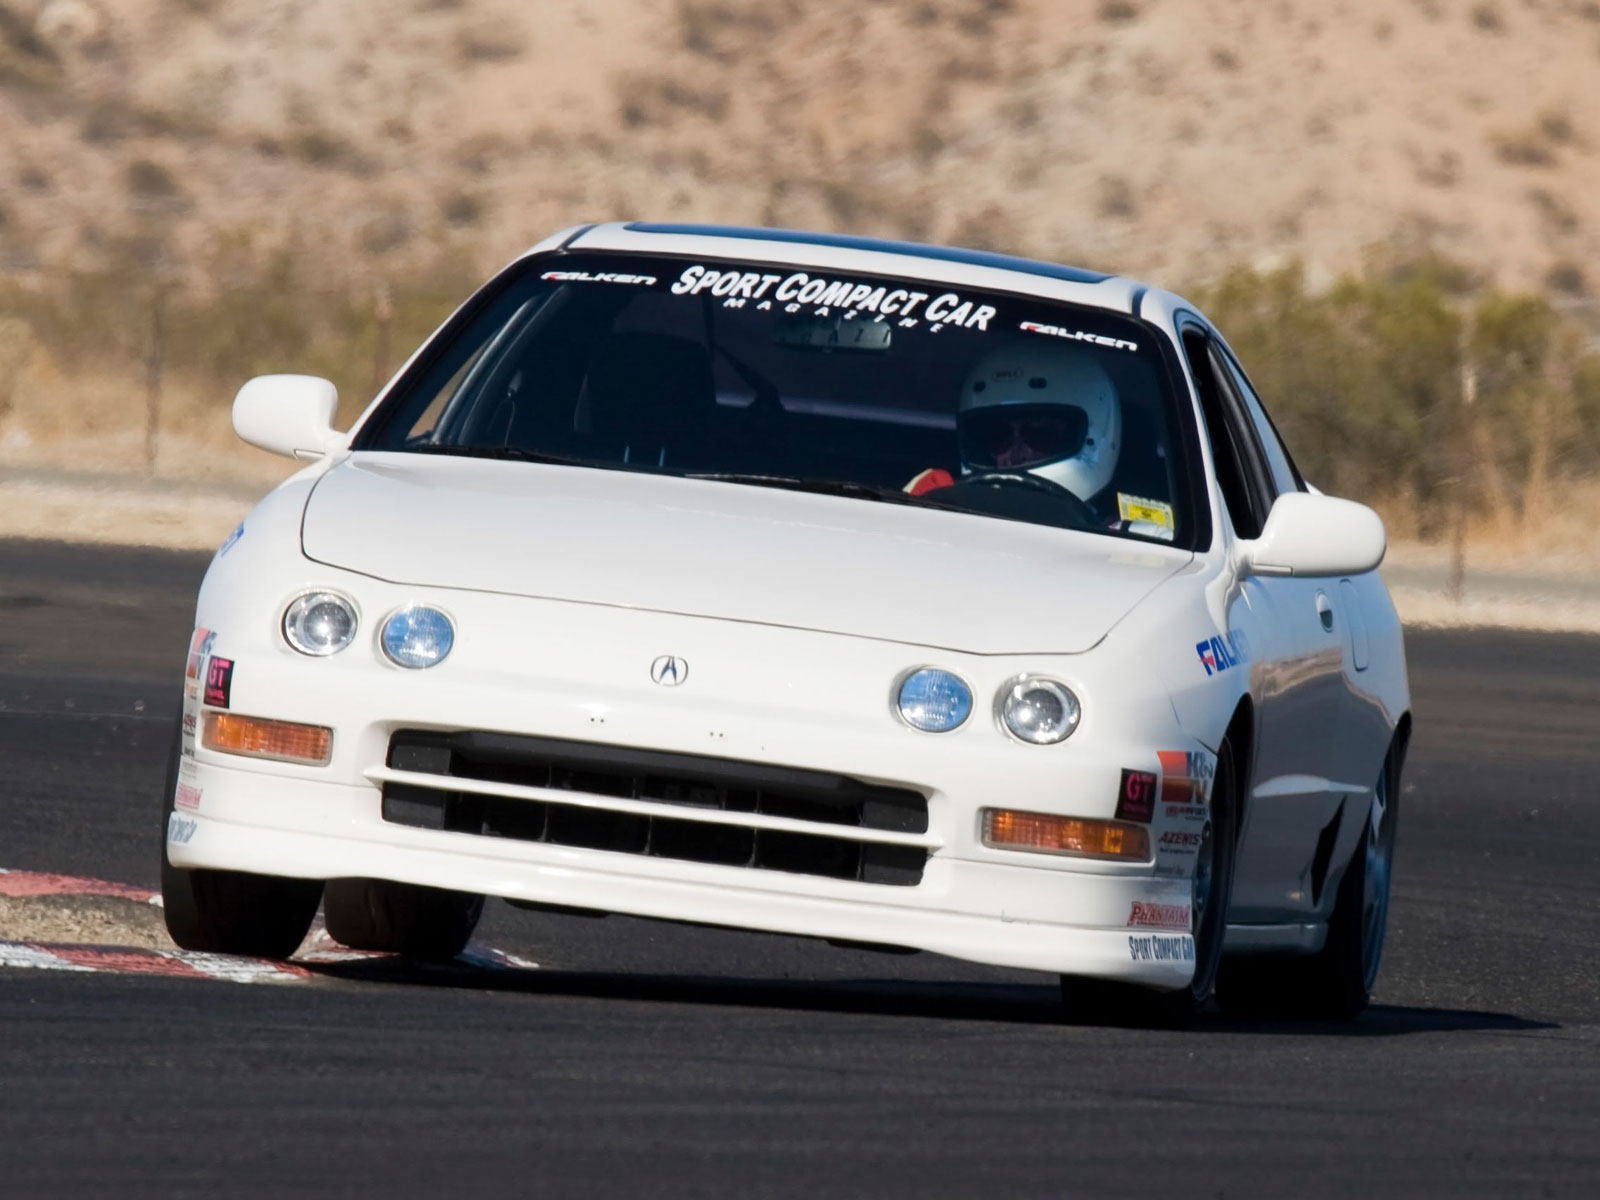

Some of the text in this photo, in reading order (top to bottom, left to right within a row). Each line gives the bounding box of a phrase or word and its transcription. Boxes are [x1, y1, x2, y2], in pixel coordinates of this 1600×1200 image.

[671, 265, 997, 331] SPORT COMPACT CAR
[722, 297, 944, 333] MAGAZINE
[208, 658, 230, 688] GT
[1126, 771, 1153, 802] GT
[1158, 832, 1200, 846] AZENIS
